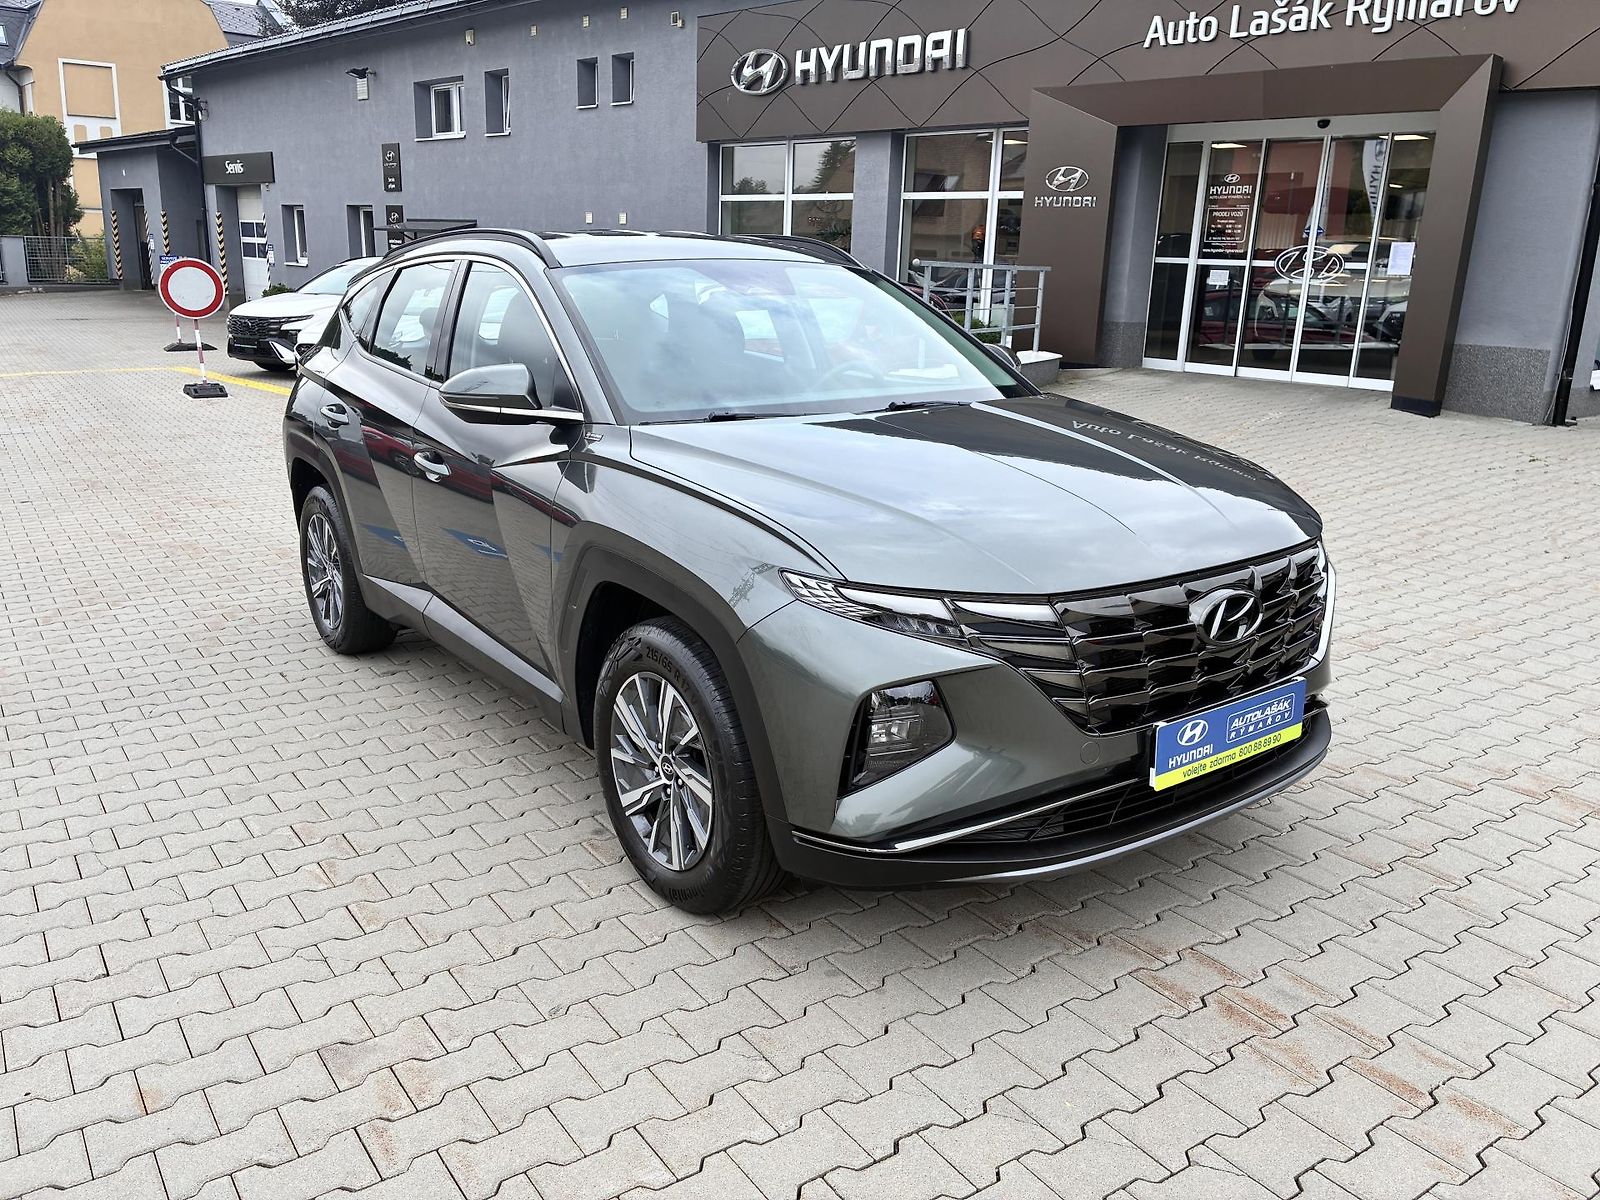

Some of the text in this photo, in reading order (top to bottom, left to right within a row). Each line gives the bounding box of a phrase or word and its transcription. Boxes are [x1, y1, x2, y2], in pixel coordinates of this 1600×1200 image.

[1142, 14, 1219, 48] Auto
[795, 28, 968, 85] HYUNDAI
[225, 160, 244, 174] Servis
[1034, 196, 1097, 207] HYUNDAI
[1209, 185, 1253, 195] HYUNDAI
[1230, 699, 1292, 729] AUTOLAŠÁK
[1168, 743, 1214, 769] HYUNDAI
[1182, 733, 1282, 778] volejte zdarma 800 88 89 90
